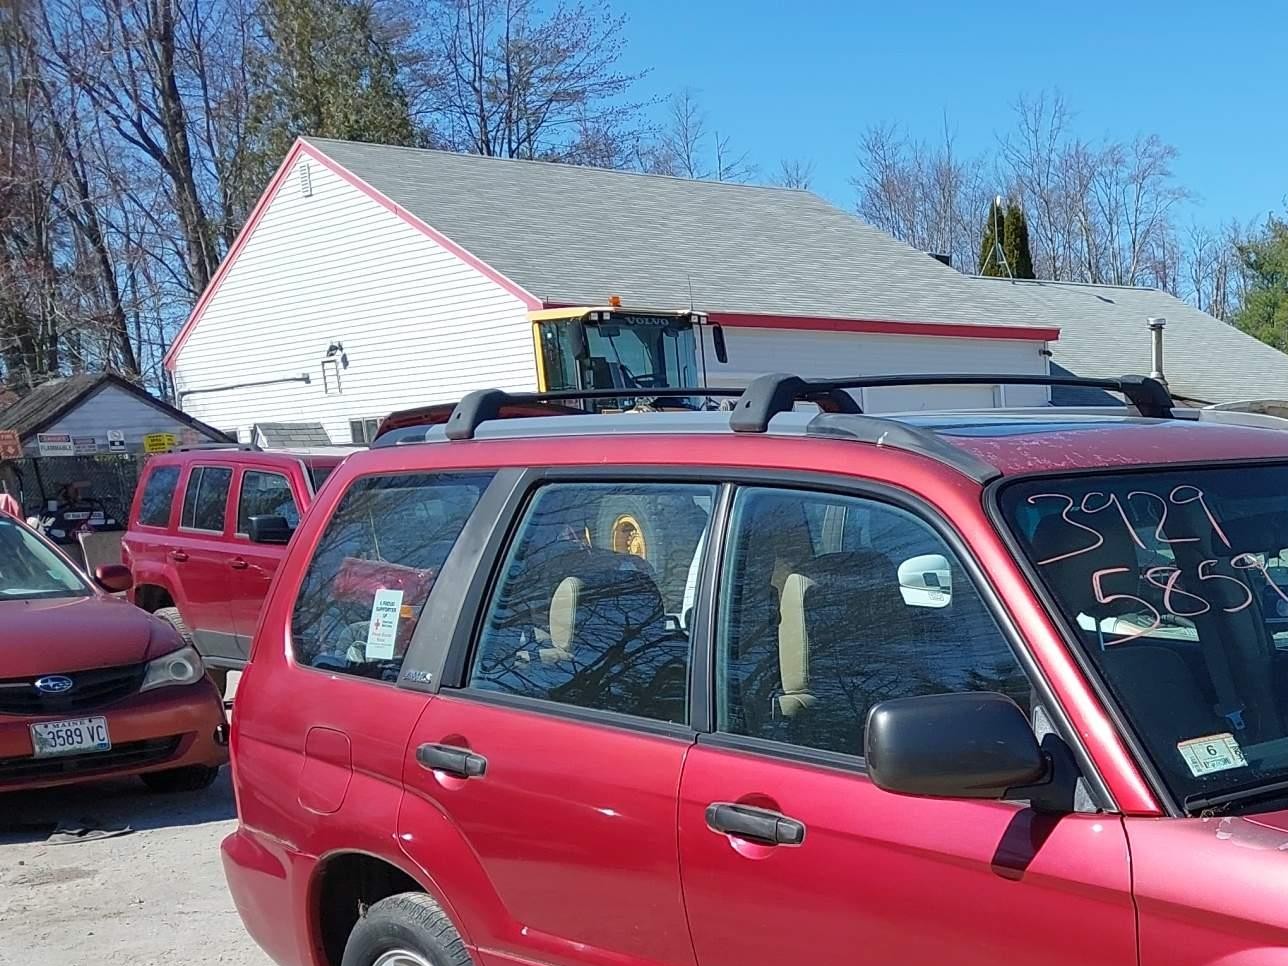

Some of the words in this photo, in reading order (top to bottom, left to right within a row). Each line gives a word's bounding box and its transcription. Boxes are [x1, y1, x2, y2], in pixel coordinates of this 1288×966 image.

[624, 316, 669, 326] VOLVO
[1028, 485, 1232, 566] 3929
[53, 720, 86, 729] MAINE
[47, 727, 83, 748] 3589
[87, 725, 105, 743] VC
[1206, 745, 1217, 756] 6
